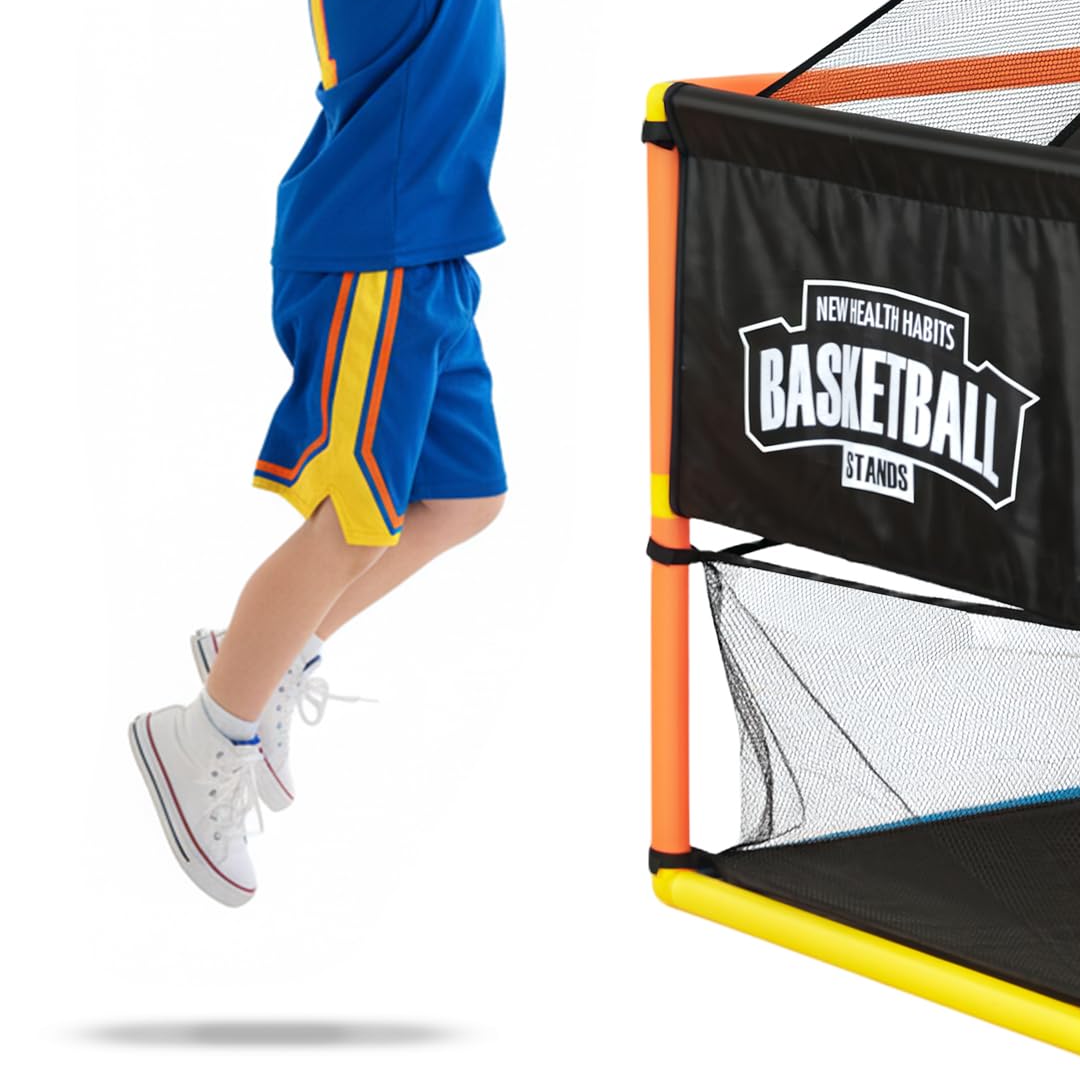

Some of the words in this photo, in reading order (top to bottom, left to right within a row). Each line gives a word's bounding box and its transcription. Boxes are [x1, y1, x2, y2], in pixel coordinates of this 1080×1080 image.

[816, 296, 848, 322] NEW
[850, 298, 899, 333] HEALTH
[902, 309, 955, 350] HABITS
[760, 342, 999, 489] BASKETBALL
[846, 451, 908, 492] STANDS
